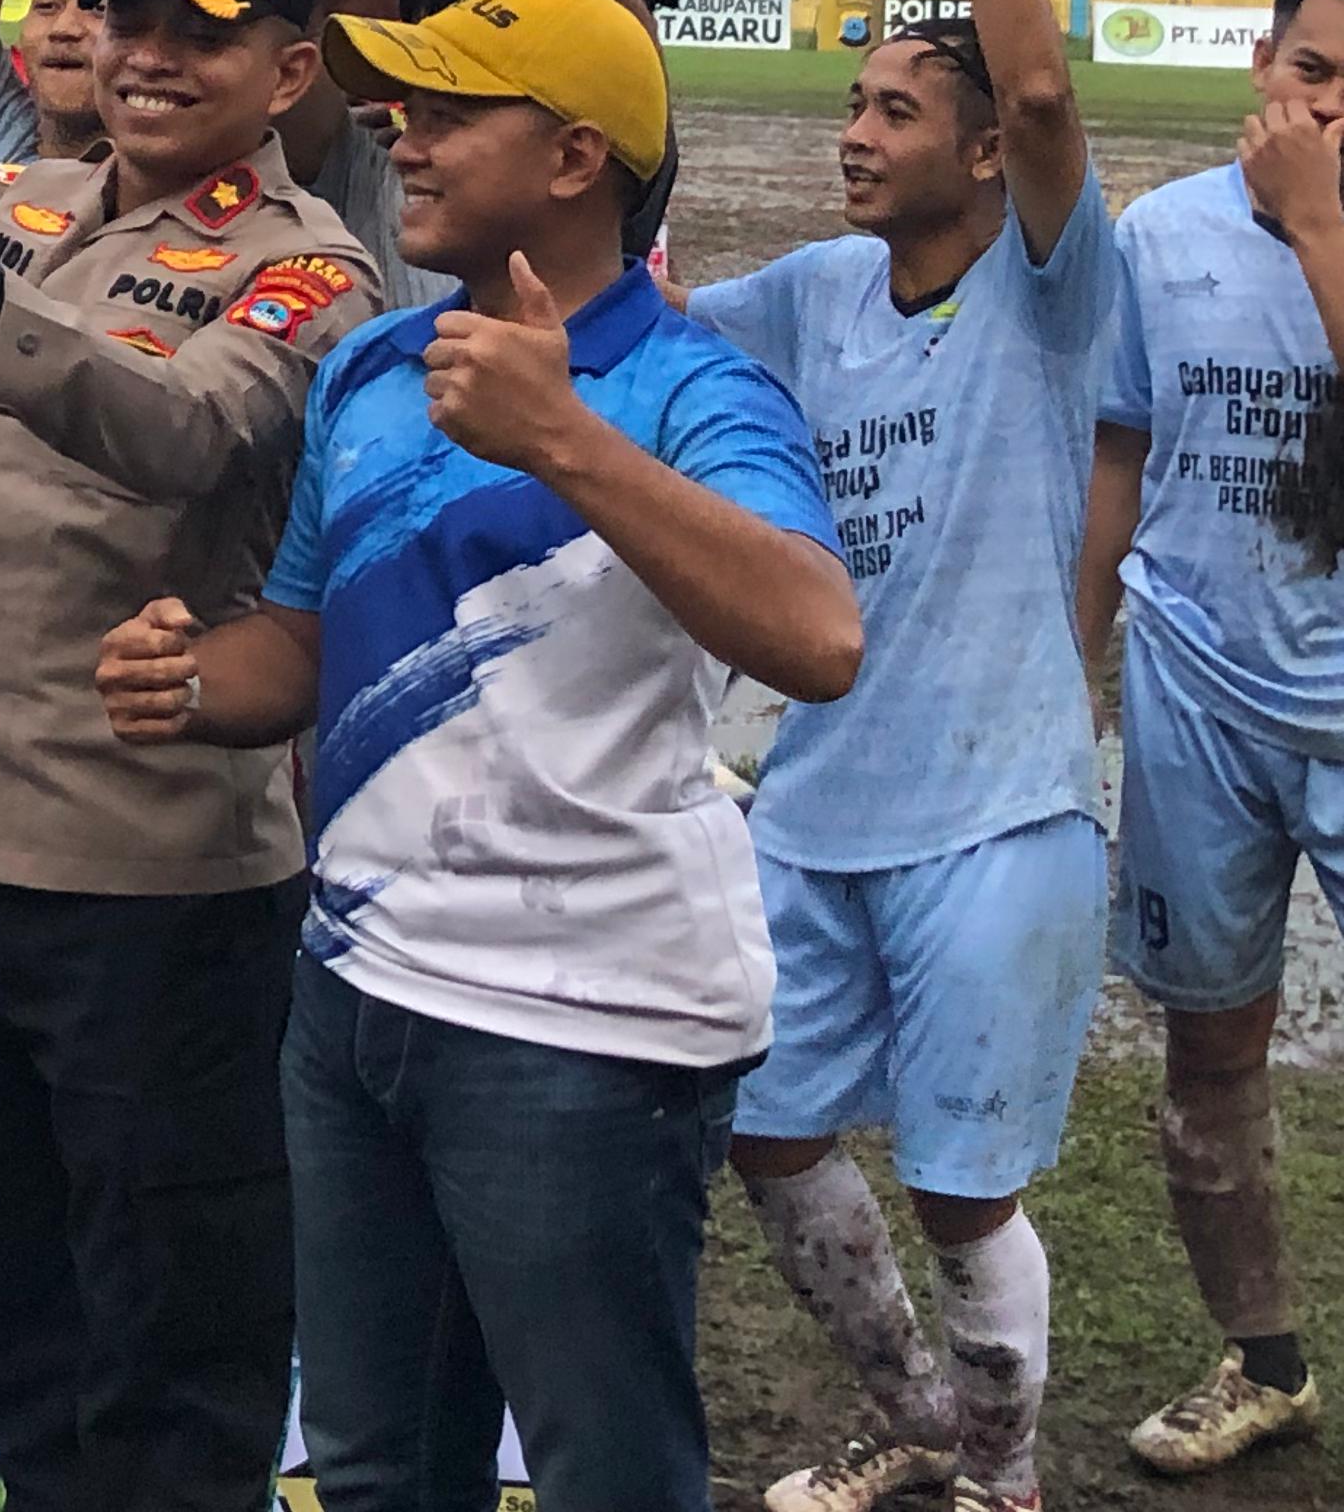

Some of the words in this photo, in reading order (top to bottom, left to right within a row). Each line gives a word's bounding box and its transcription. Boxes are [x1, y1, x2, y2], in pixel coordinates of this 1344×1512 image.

[659, 15, 782, 44] TABARU
[108, 273, 220, 325] POLRI
[1178, 357, 1283, 402] Cahaya
[1227, 399, 1303, 440] Grou
[823, 464, 881, 502] roup
[1179, 453, 1204, 481] PT.
